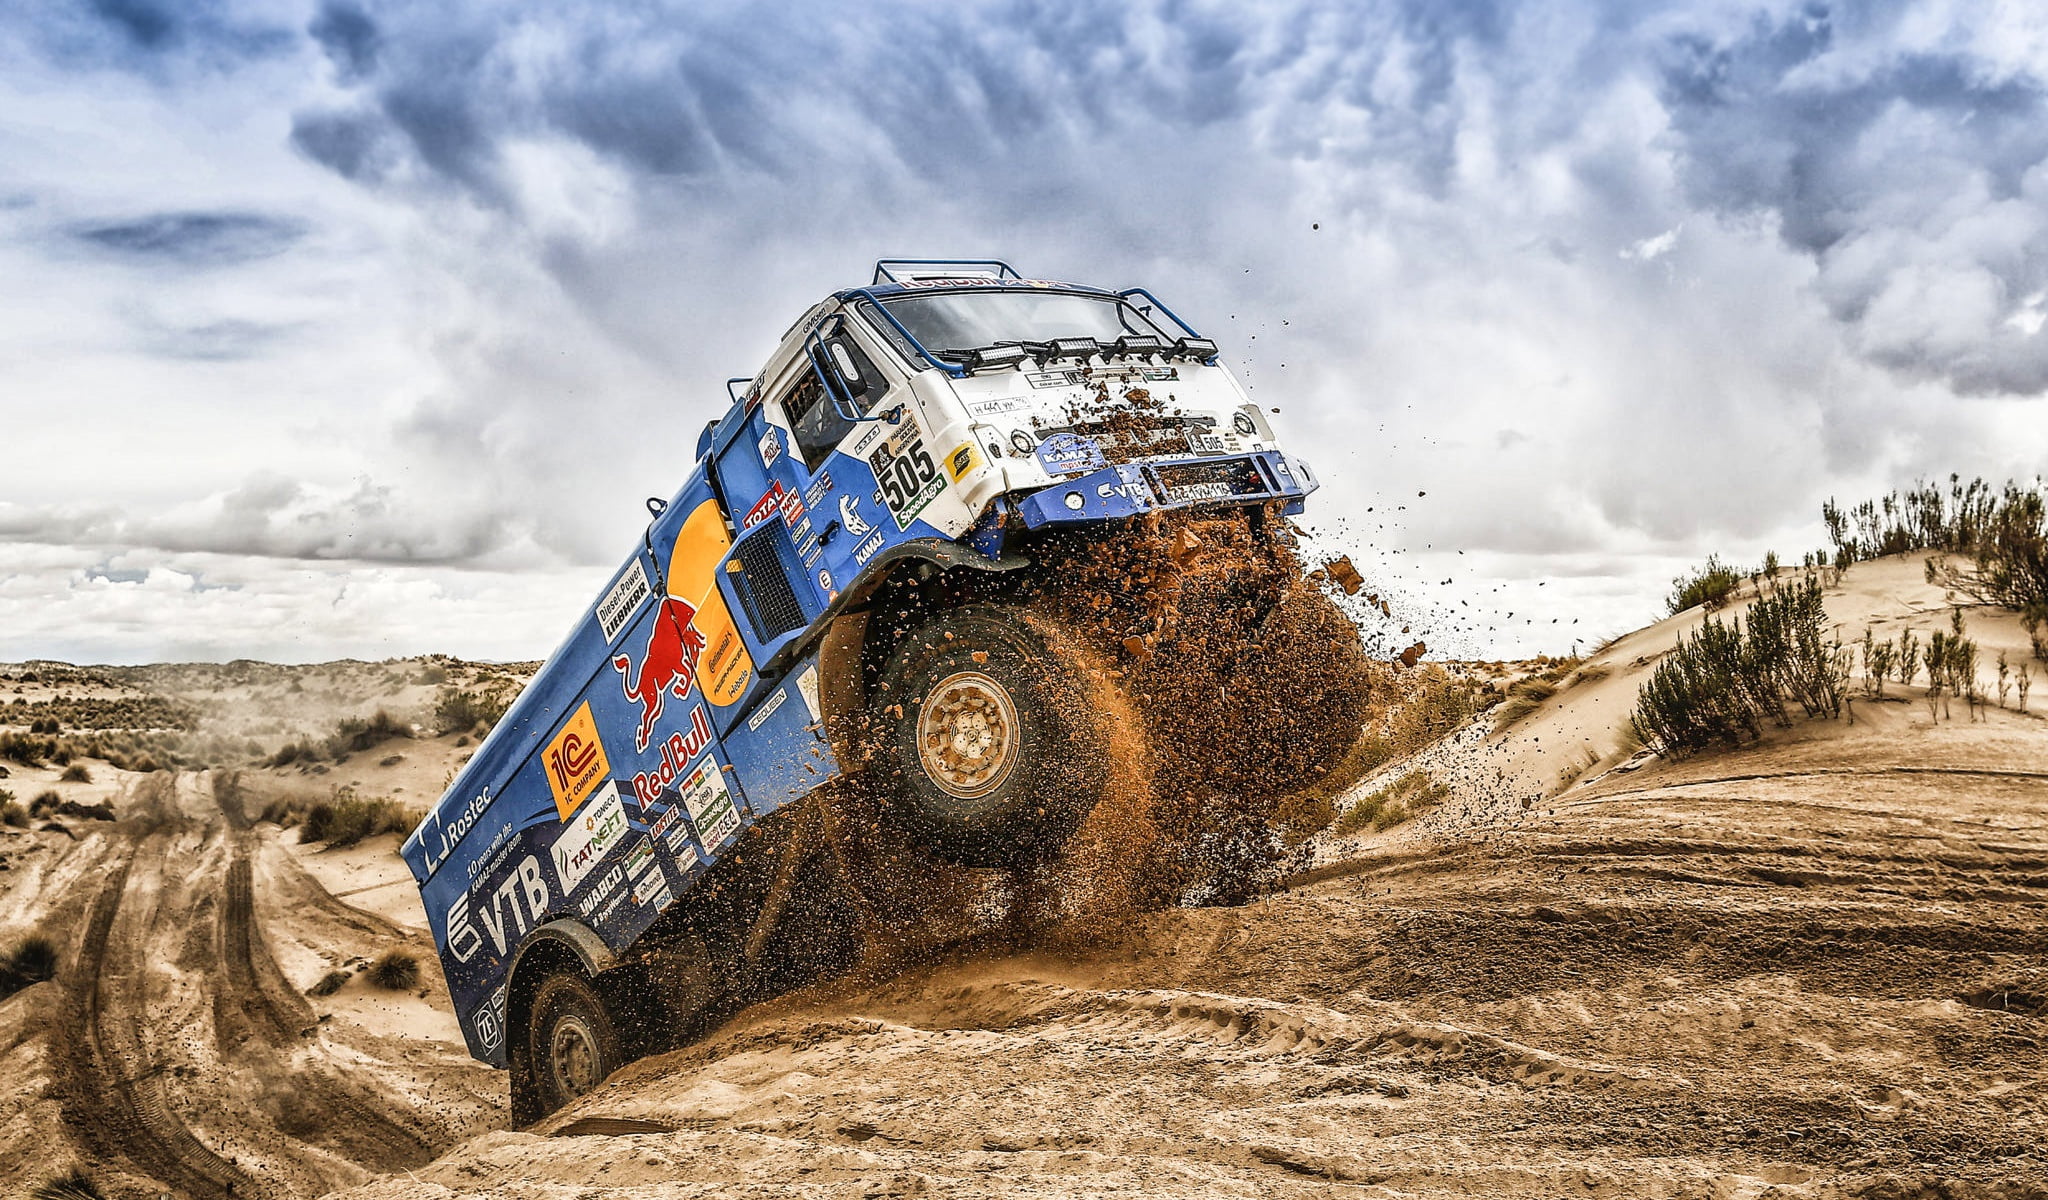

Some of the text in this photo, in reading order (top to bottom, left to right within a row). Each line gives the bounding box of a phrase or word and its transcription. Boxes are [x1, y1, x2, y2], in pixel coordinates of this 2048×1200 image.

[1203, 436, 1225, 450] 505
[879, 438, 936, 512] 505
[1114, 482, 1145, 499] VTB
[744, 491, 786, 529] TOTAL
[899, 478, 944, 524] SpeedAgro
[855, 531, 886, 567] KAMAZ
[599, 565, 642, 621] Diesel-Power
[606, 581, 648, 638] LIEBHERR
[708, 635, 732, 674] Continental
[750, 691, 786, 730] ICEQUEEN
[573, 760, 602, 797] COMPANY
[632, 743, 677, 814] Red
[669, 703, 713, 774] Bull
[447, 785, 492, 847] Rostec
[571, 808, 623, 870] TATNEFT
[651, 804, 679, 840] LOCTITE
[467, 859, 478, 879] 10
[476, 848, 492, 870] years
[502, 822, 513, 840] the
[507, 831, 522, 855] team
[478, 853, 549, 958] VTB
[579, 863, 624, 918] WABCO
